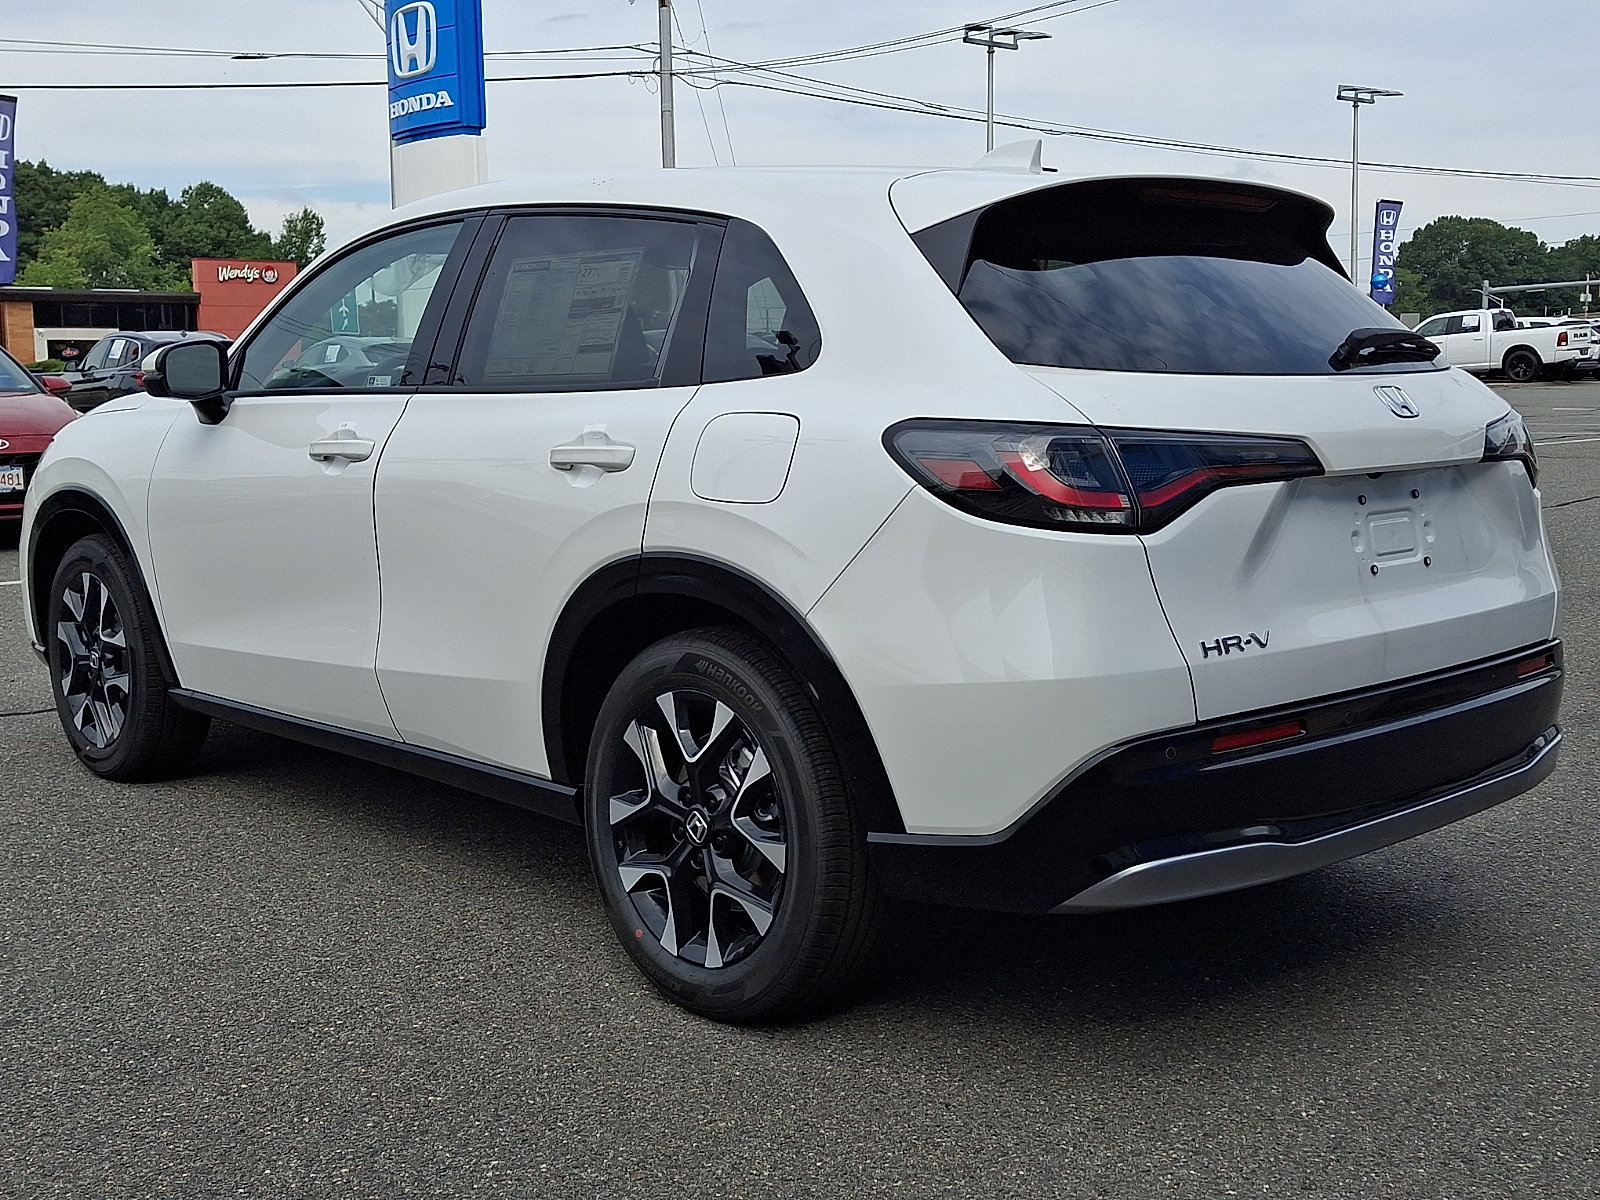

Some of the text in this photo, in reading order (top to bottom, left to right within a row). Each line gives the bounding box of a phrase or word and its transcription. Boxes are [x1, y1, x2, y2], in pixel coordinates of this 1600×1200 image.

[390, 90, 454, 119] HONDA
[218, 264, 260, 282] Wendy's
[0, 472, 22, 486] 481
[1200, 630, 1269, 658] HR-V
